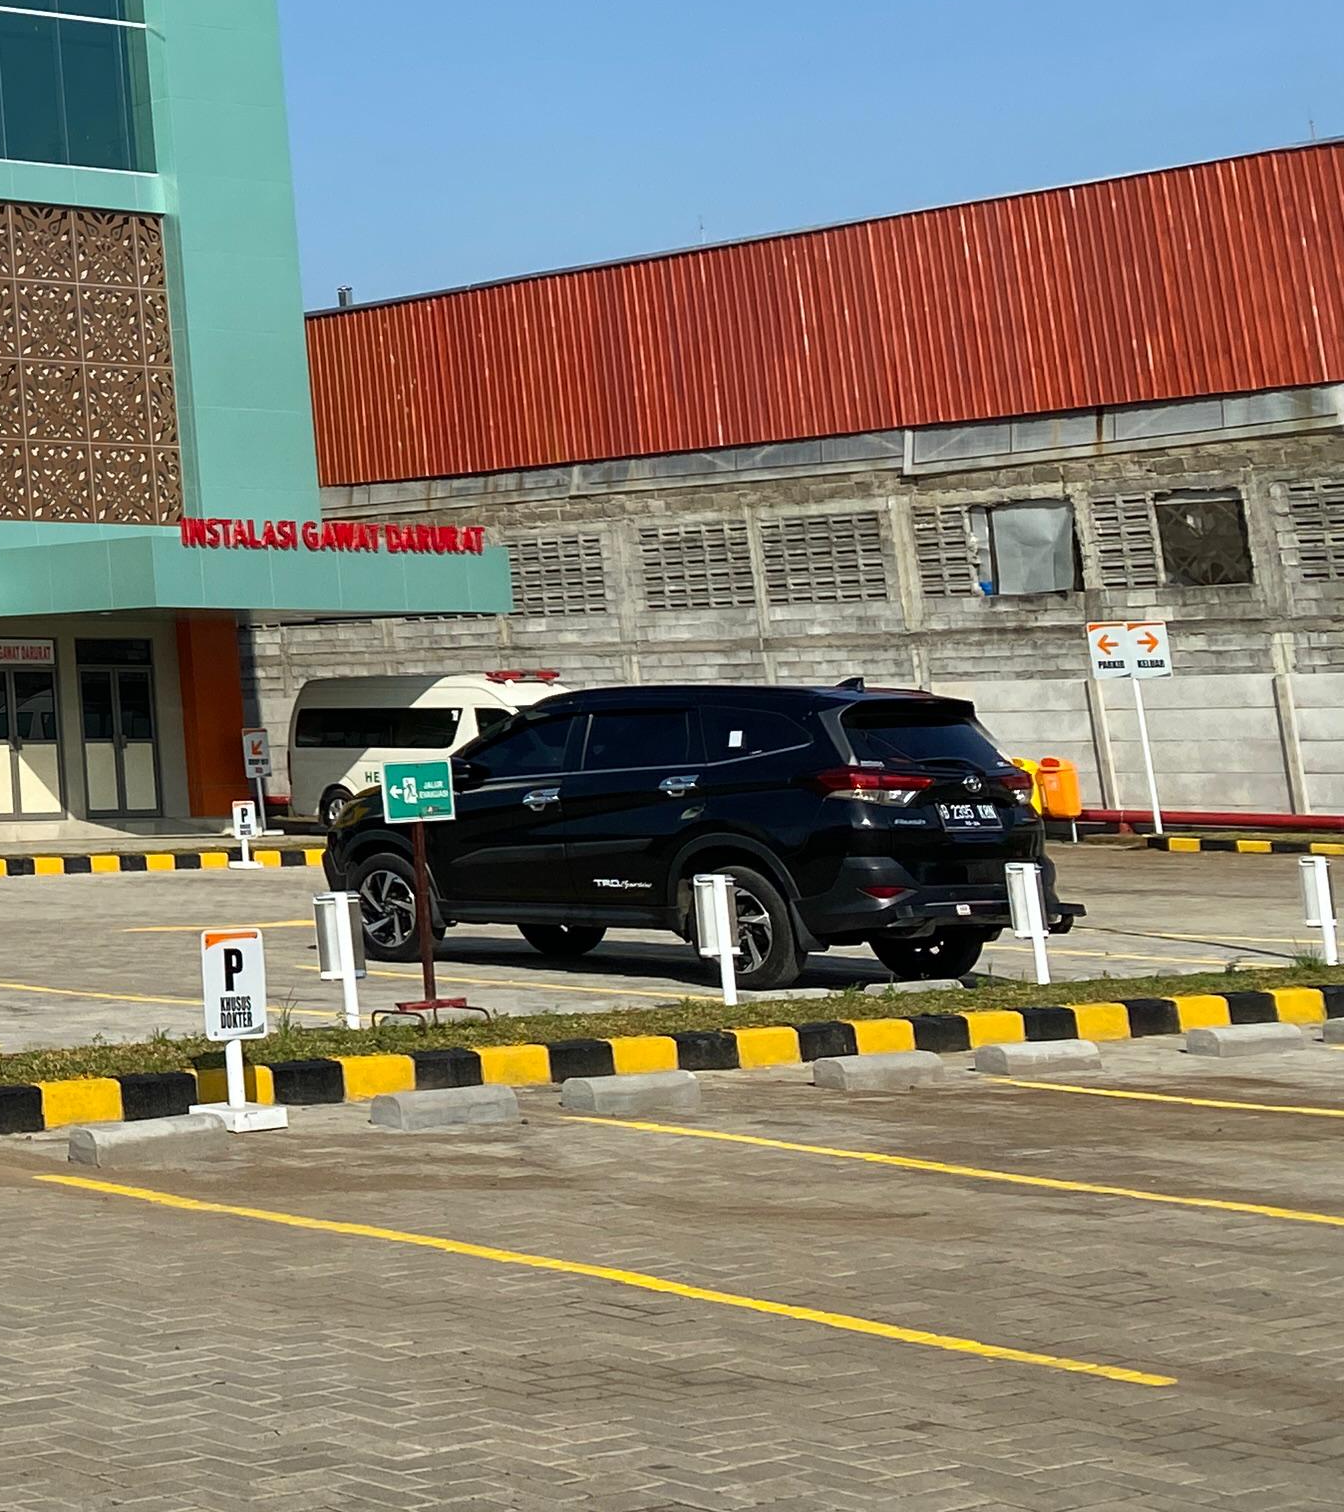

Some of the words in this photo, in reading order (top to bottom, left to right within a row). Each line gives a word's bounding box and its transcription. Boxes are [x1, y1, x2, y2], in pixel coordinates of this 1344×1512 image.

[180, 517, 298, 551] INSTALASI
[302, 520, 379, 553] GAWAT
[384, 523, 486, 555] DARURAT
[241, 807, 248, 823] P
[223, 948, 243, 992] P
[220, 995, 252, 1012] KHUSUS
[220, 1011, 253, 1029] DOKTER
